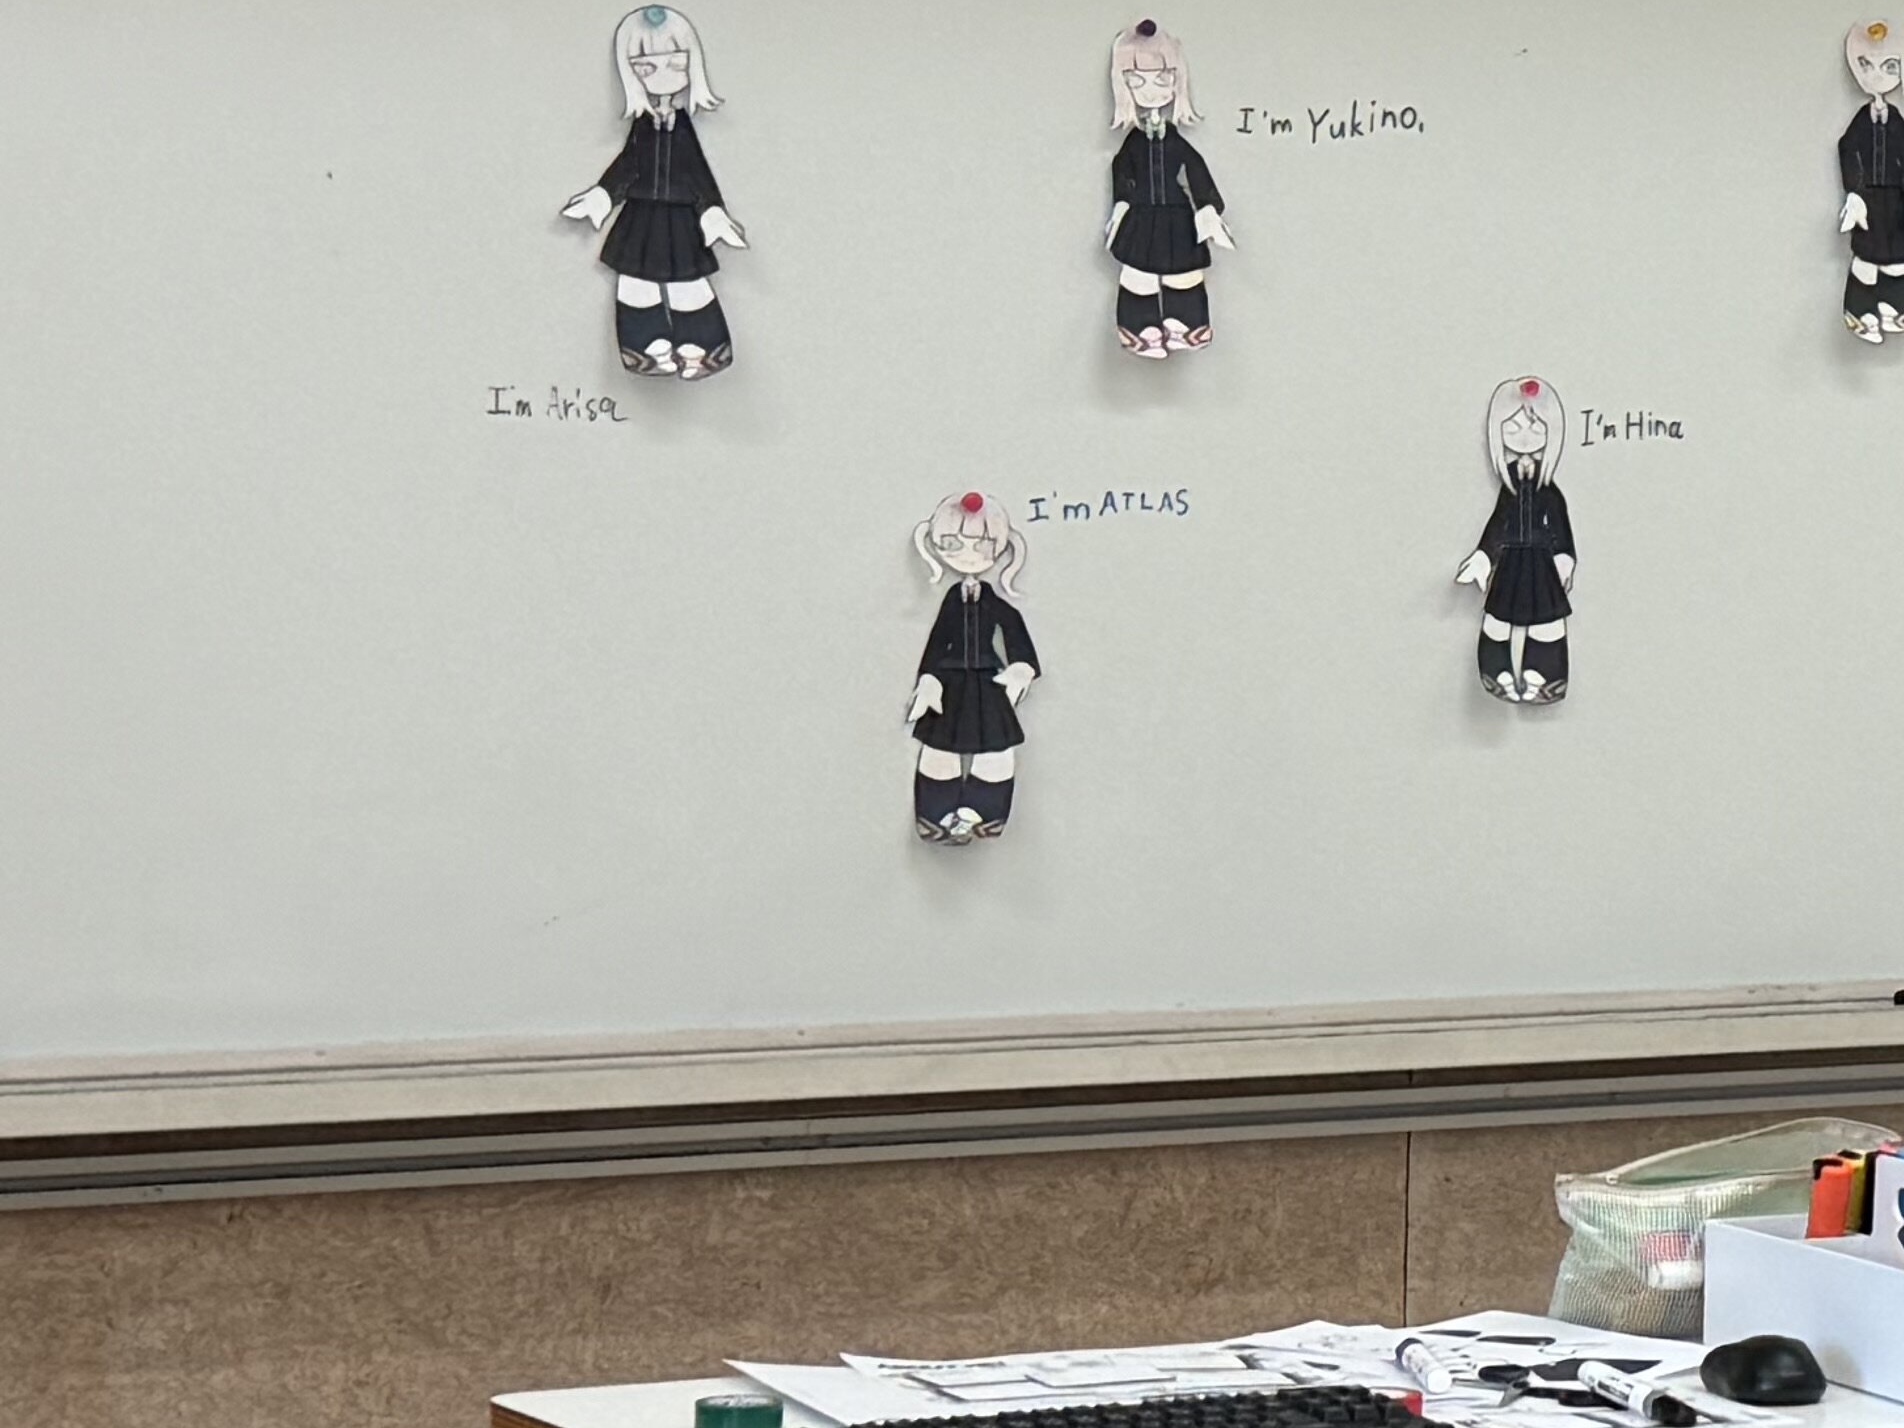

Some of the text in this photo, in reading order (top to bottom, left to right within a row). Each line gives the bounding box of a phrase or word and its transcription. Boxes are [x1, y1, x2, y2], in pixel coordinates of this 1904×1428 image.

[1236, 107, 1292, 135] I'm
[547, 386, 629, 421] Arisa
[1580, 408, 1684, 447] I'm Hina
[1027, 488, 1190, 523] I'm ATLAS
